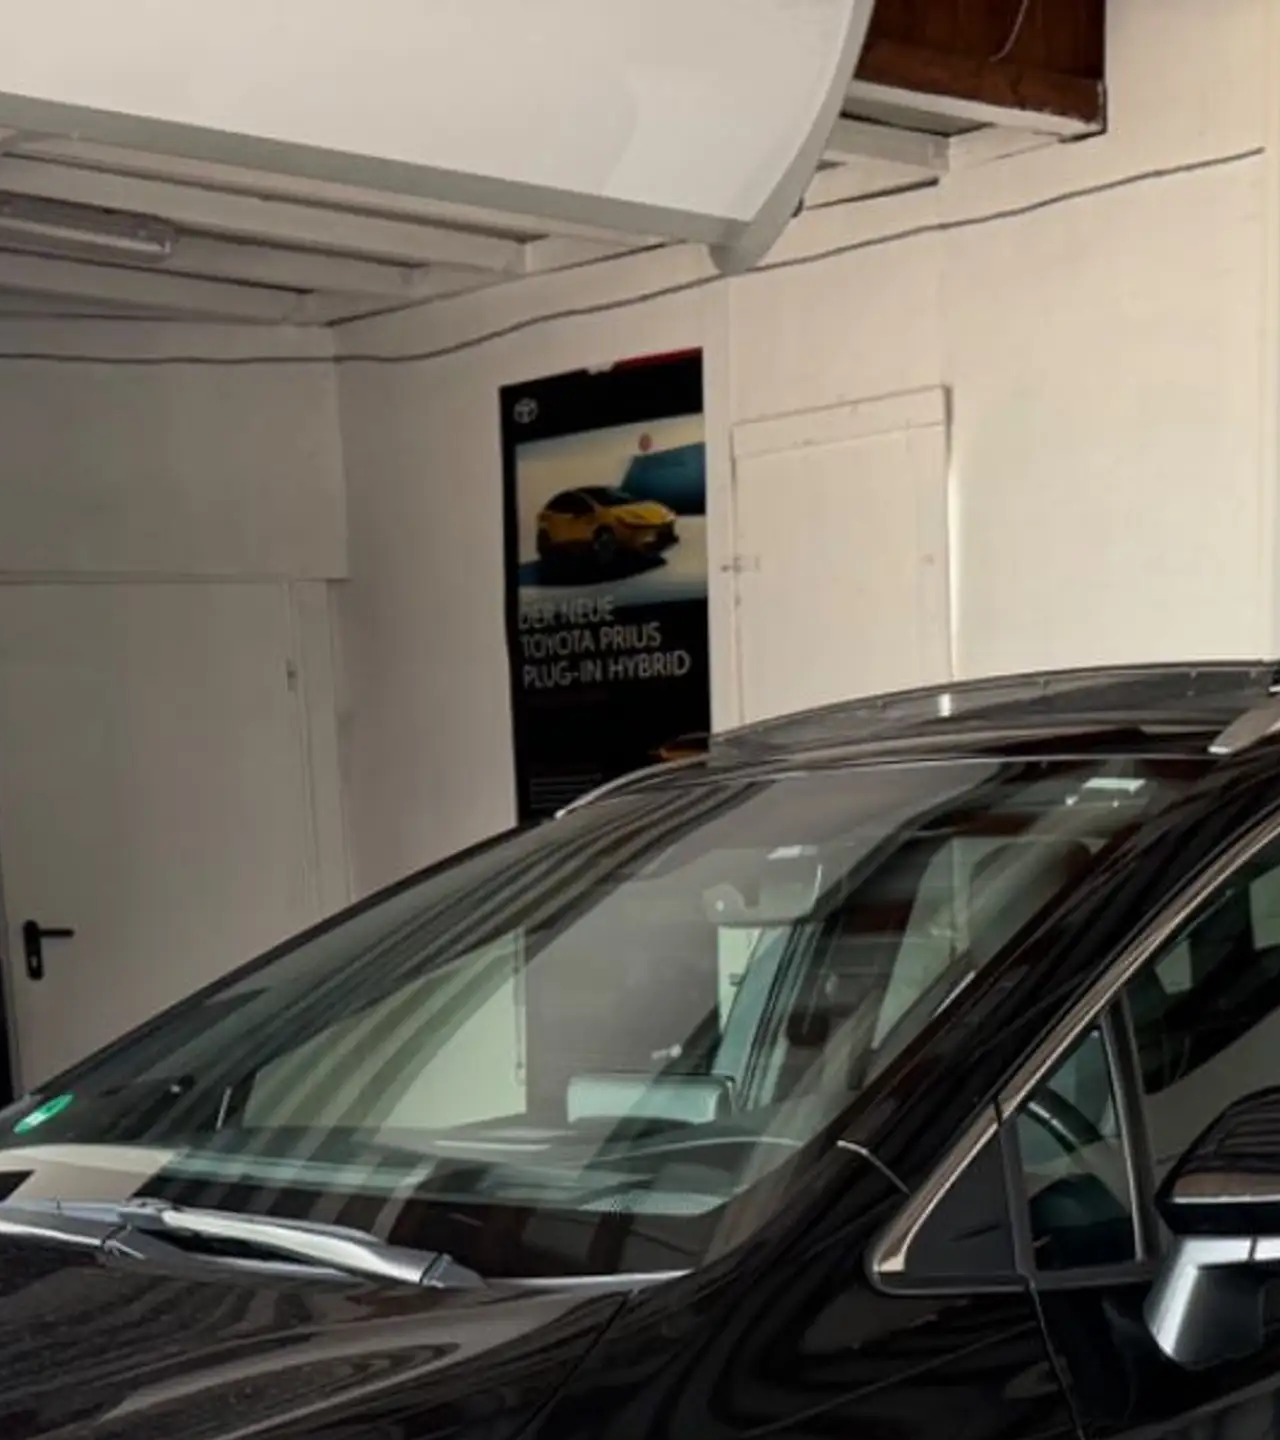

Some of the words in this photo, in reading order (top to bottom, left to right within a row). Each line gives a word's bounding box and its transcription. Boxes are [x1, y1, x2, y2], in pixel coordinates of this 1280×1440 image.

[518, 605, 556, 629] DER
[560, 597, 615, 623] NEUE
[520, 629, 596, 658] TOYOTA
[599, 621, 663, 652] PRIUS
[522, 658, 604, 690] PLUG-IN
[609, 651, 691, 680] HYBRID
